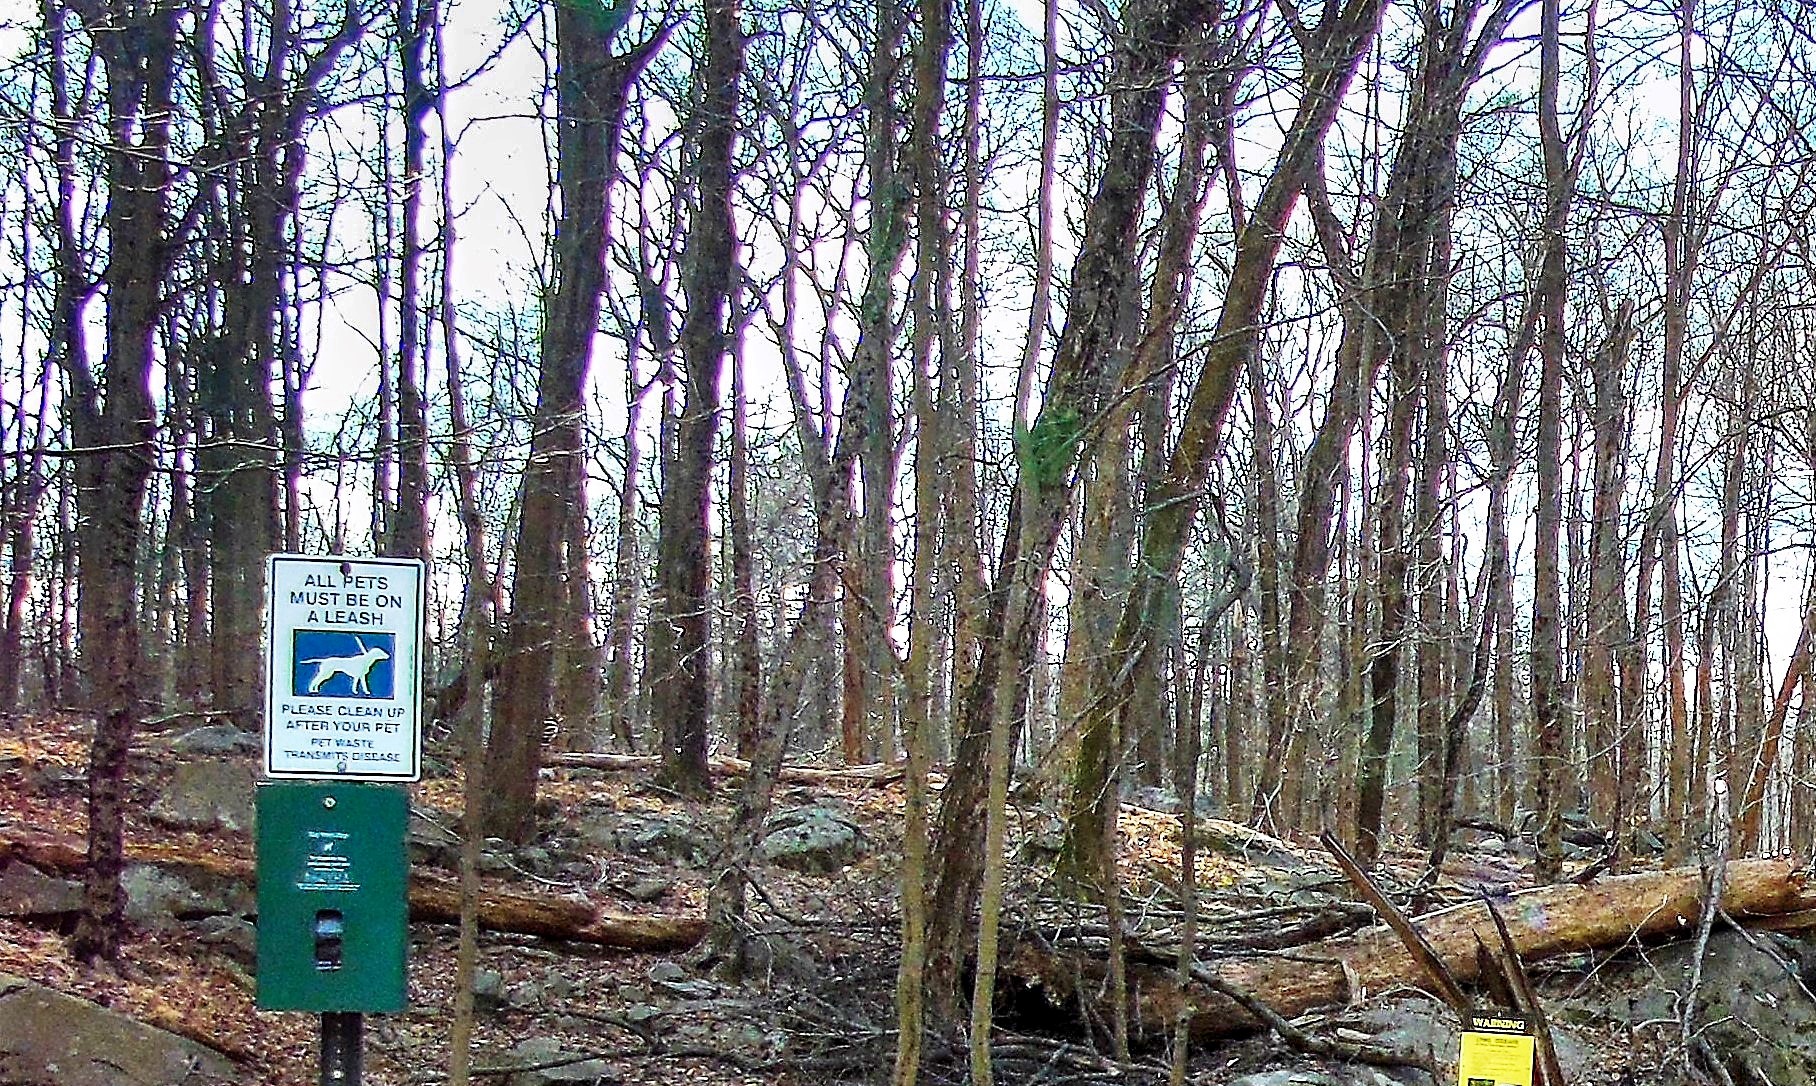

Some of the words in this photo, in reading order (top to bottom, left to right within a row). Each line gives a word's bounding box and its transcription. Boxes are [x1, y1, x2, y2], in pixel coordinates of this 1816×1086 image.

[304, 574, 336, 589] ALL
[343, 575, 389, 590] PETS
[290, 591, 340, 606] MUST
[346, 593, 370, 607] BE
[375, 595, 402, 609] ON
[307, 610, 319, 623] A
[324, 611, 384, 625] LEASH
[282, 704, 333, 716] PLEASE
[338, 705, 383, 717] CLEAN
[387, 706, 406, 718] UP
[285, 720, 329, 732] AFTER
[333, 721, 371, 732] YOUR
[375, 722, 401, 734] PET
[310, 738, 332, 748] PET
[335, 739, 374, 749] WASTE
[284, 750, 349, 761] TRANSMITS
[351, 751, 401, 762] DISEASE
[1472, 1018, 1525, 1029] WARNING
